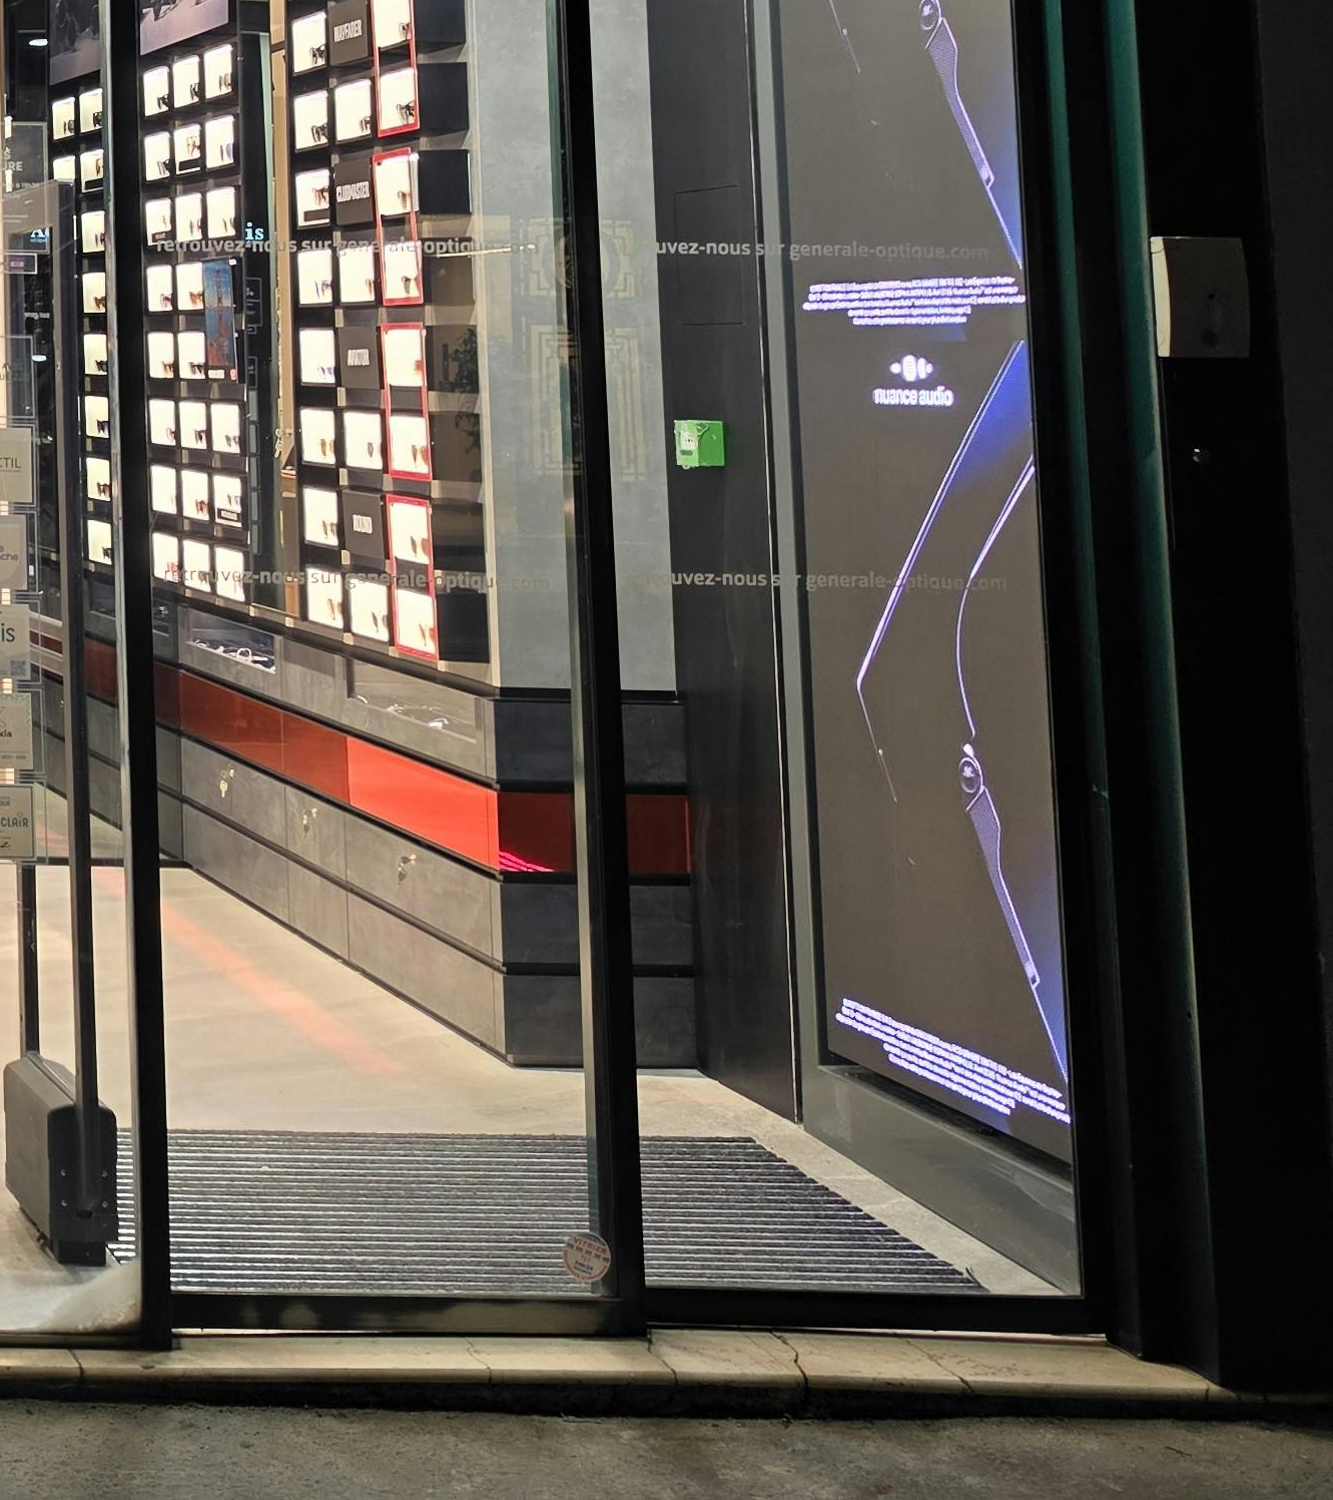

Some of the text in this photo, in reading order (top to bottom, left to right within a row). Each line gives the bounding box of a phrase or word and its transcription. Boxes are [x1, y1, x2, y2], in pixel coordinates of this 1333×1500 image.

[657, 240, 989, 262] uvez-nous sr generale-optique.com
[873, 385, 955, 406] nuance audio
[310, 571, 339, 584] sur
[343, 567, 550, 590] generale-optiqu.com
[771, 573, 801, 587] sr
